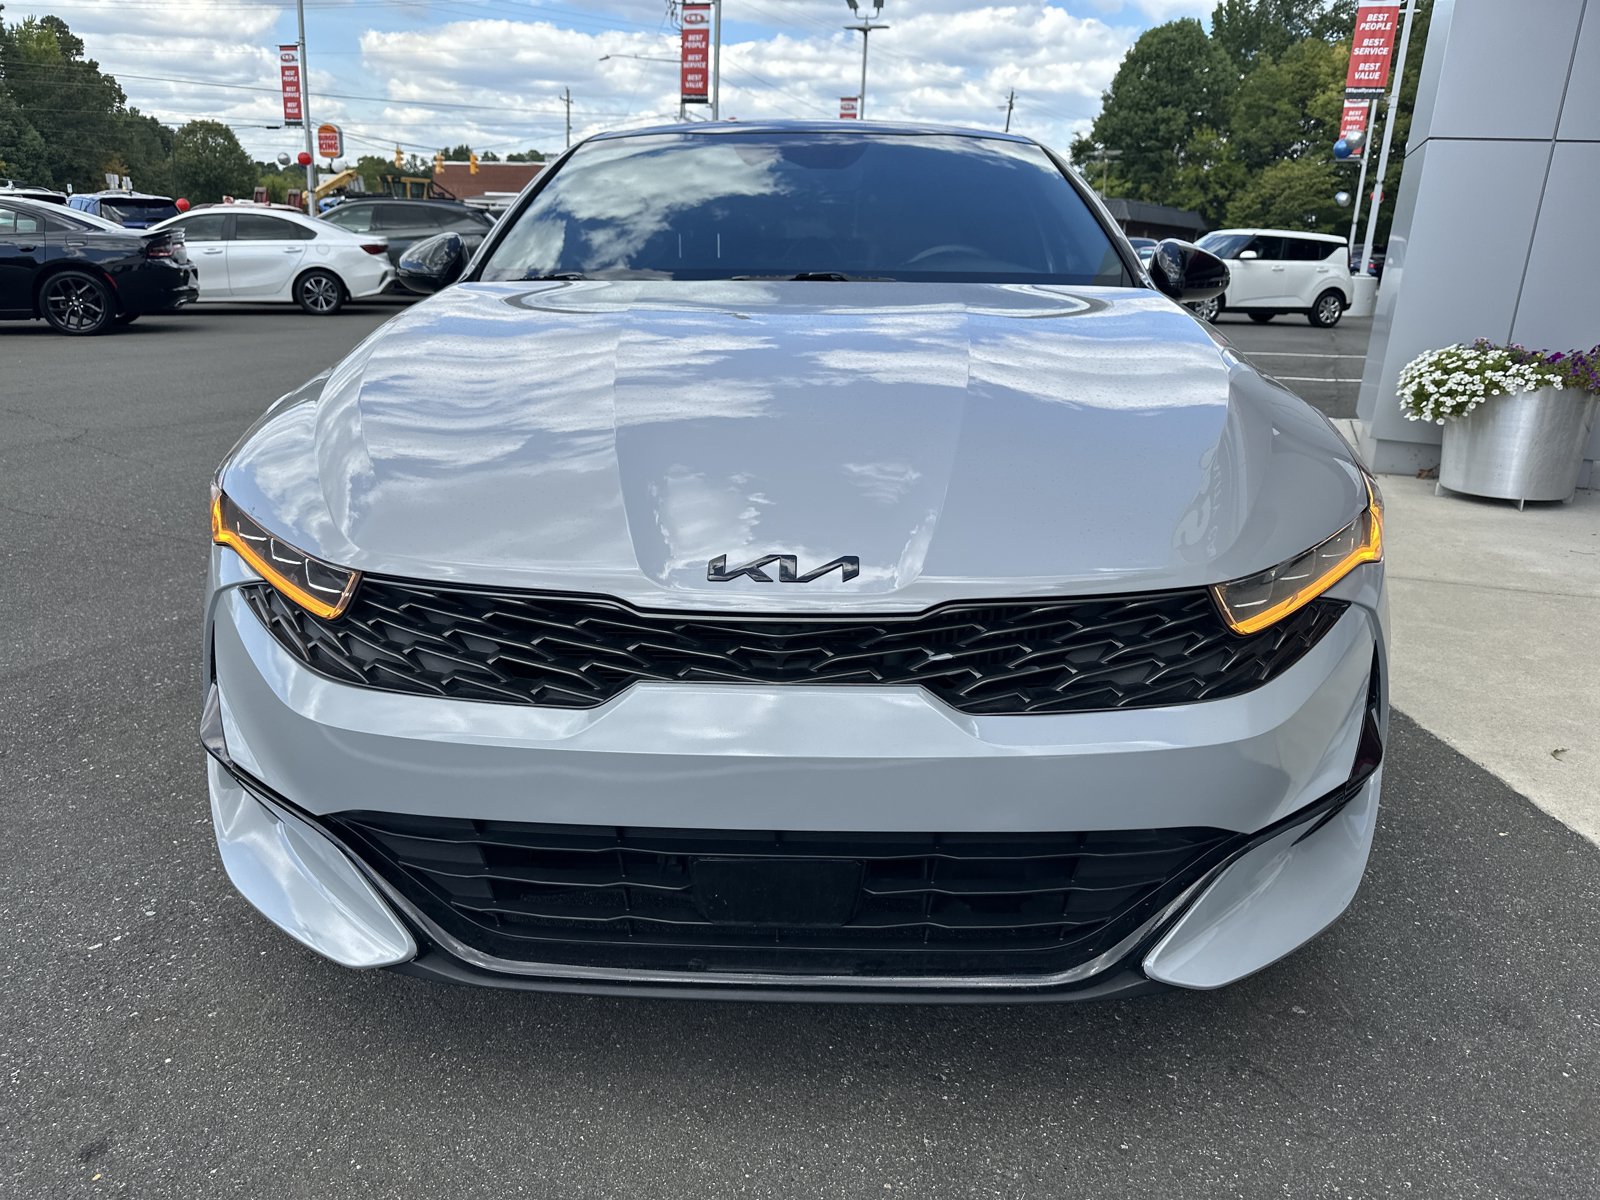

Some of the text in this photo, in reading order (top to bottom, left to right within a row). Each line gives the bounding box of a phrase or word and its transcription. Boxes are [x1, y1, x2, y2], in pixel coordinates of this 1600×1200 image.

[684, 41, 706, 49] PEOPLE
[1354, 72, 1380, 80] VALUE
[319, 142, 338, 150] KING
